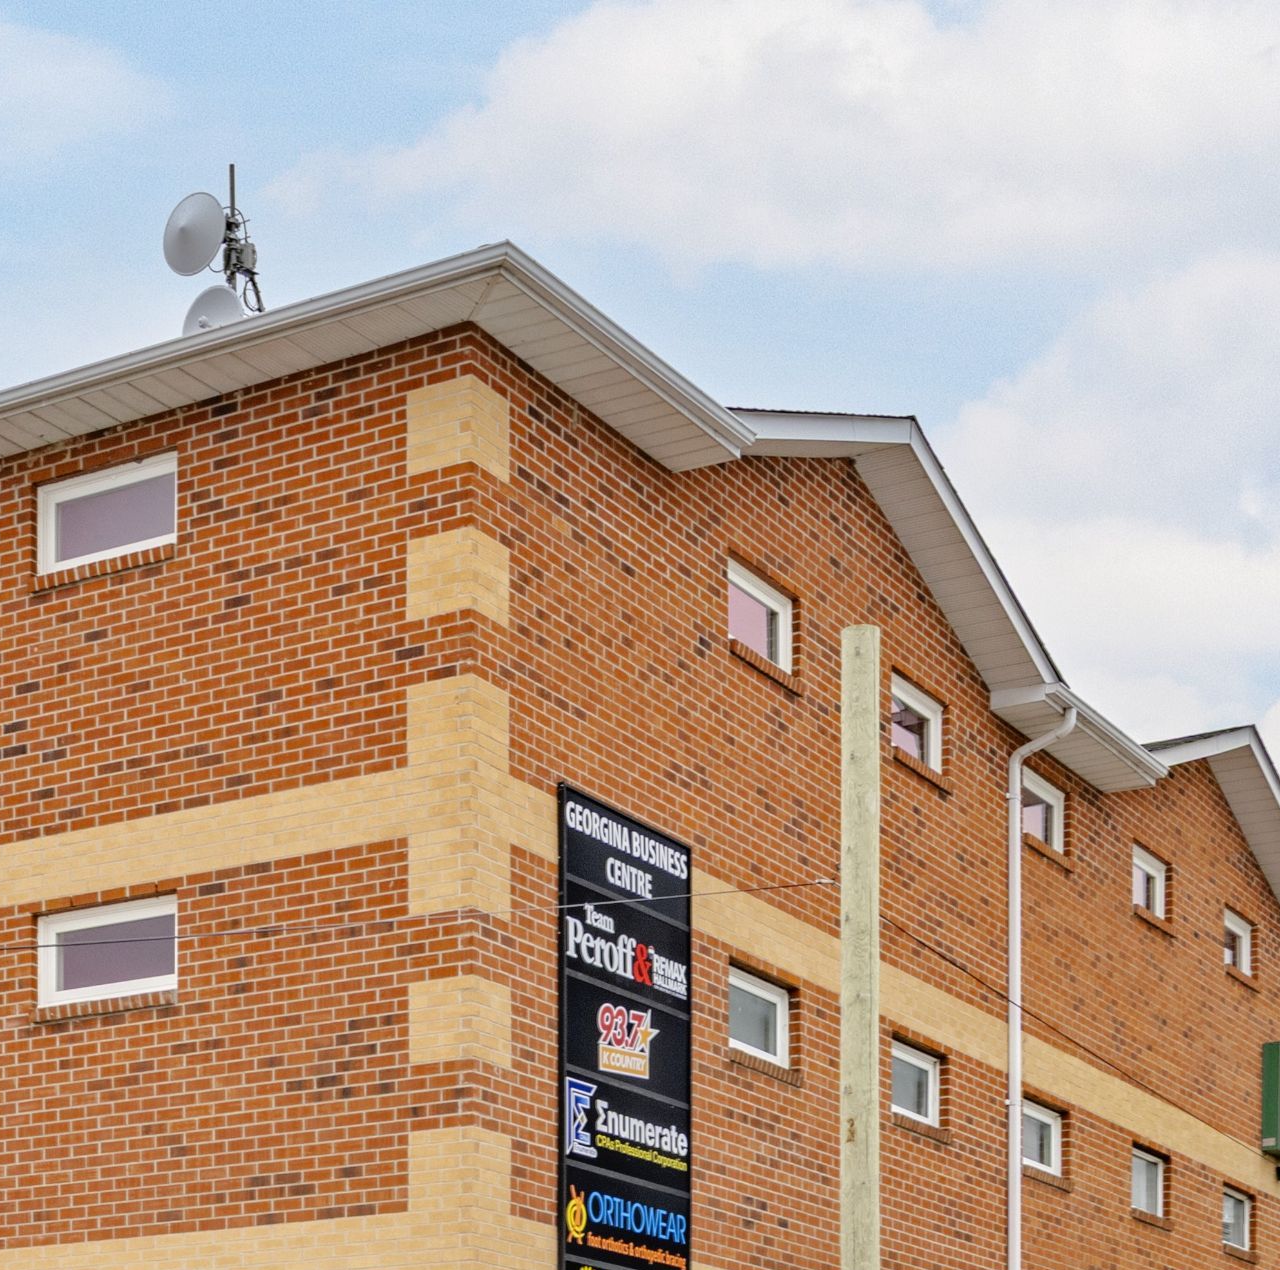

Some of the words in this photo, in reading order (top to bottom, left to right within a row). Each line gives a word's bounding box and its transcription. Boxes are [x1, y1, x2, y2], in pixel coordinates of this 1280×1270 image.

[565, 801, 631, 854] GEORGINA
[631, 831, 688, 880] BUSINESS
[606, 857, 653, 899] CENTRE
[583, 902, 615, 934] Team
[565, 915, 637, 981] Peroff
[600, 1004, 646, 1049] 93.7
[610, 1053, 646, 1072] COUNTRY
[615, 1139, 652, 1161] Professional
[587, 1191, 686, 1245] ORTHOWEAR
